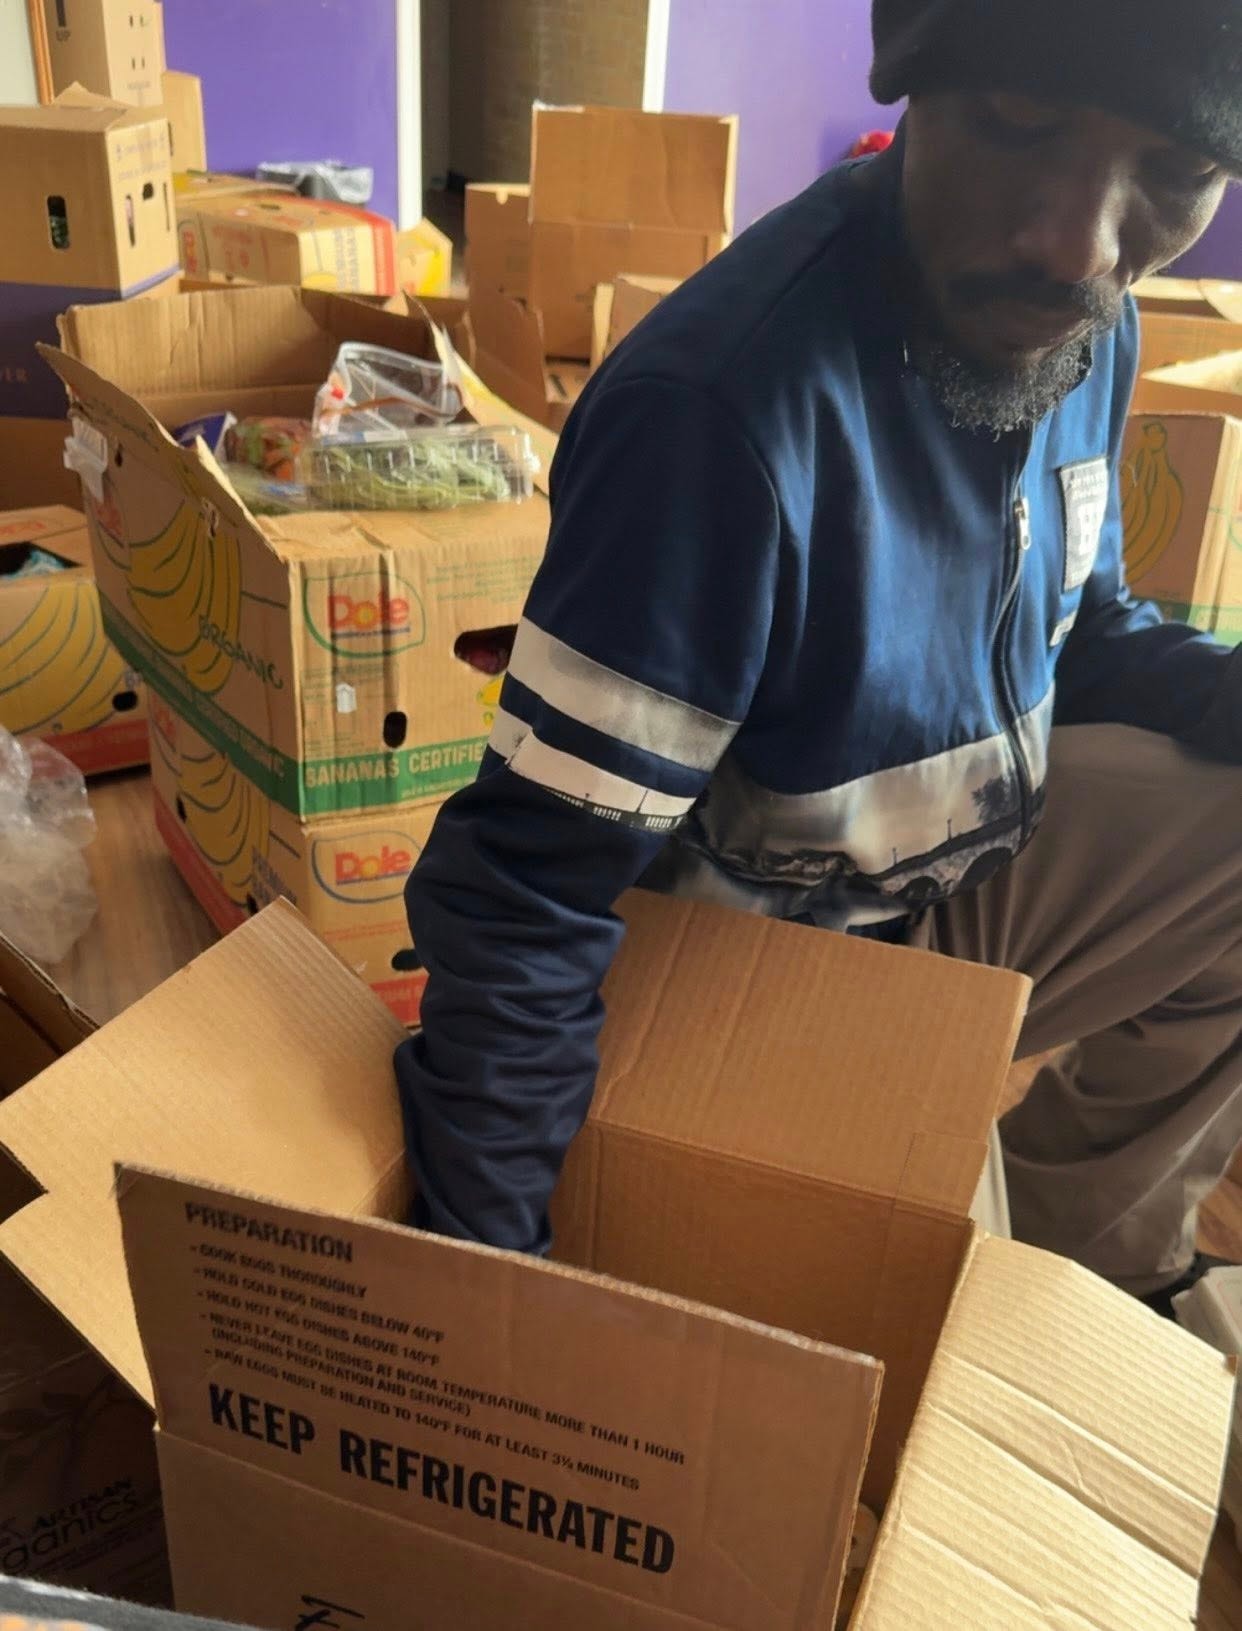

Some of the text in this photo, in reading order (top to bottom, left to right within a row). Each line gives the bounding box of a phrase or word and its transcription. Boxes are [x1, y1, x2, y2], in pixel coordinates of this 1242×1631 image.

[328, 586, 409, 630] Dole
[408, 742, 484, 774] CERTIFIE
[334, 845, 412, 882] Dole
[185, 1202, 352, 1263] PREPARATION
[203, 1268, 239, 1287] HOLD
[242, 1278, 277, 1297] COLD
[280, 1288, 306, 1306] EGG
[310, 1297, 358, 1321] DISHES
[361, 1311, 409, 1334] BELOW
[280, 1264, 367, 1298] THOROUGHLY
[206, 1290, 241, 1309] HOLD
[245, 1301, 270, 1317] HOT
[274, 1307, 299, 1326] EGG
[303, 1318, 350, 1342] DISHES
[353, 1332, 398, 1356] ABOVE
[210, 1312, 685, 1466] NEVER LEAVE EGG DISHES AT ROOM TEMPERATURE MORE THAN 1 HOUR
[211, 1327, 471, 1418] (INCLUDING PREPARATION AND SERVICE)
[214, 1348, 243, 1366] RAW
[246, 1359, 279, 1379] EGGS
[281, 1370, 317, 1391] MUST
[319, 1383, 336, 1399] BE
[339, 1390, 390, 1416] HEATED
[394, 1405, 411, 1421] TO
[455, 1423, 482, 1441] FOR
[485, 1432, 502, 1448] AT
[505, 1438, 548, 1461] LEAST
[576, 1460, 640, 1491] MINUTES
[208, 1382, 676, 1575] KEEP REFRIGERATED
[1, 1488, 138, 1574] ganics
